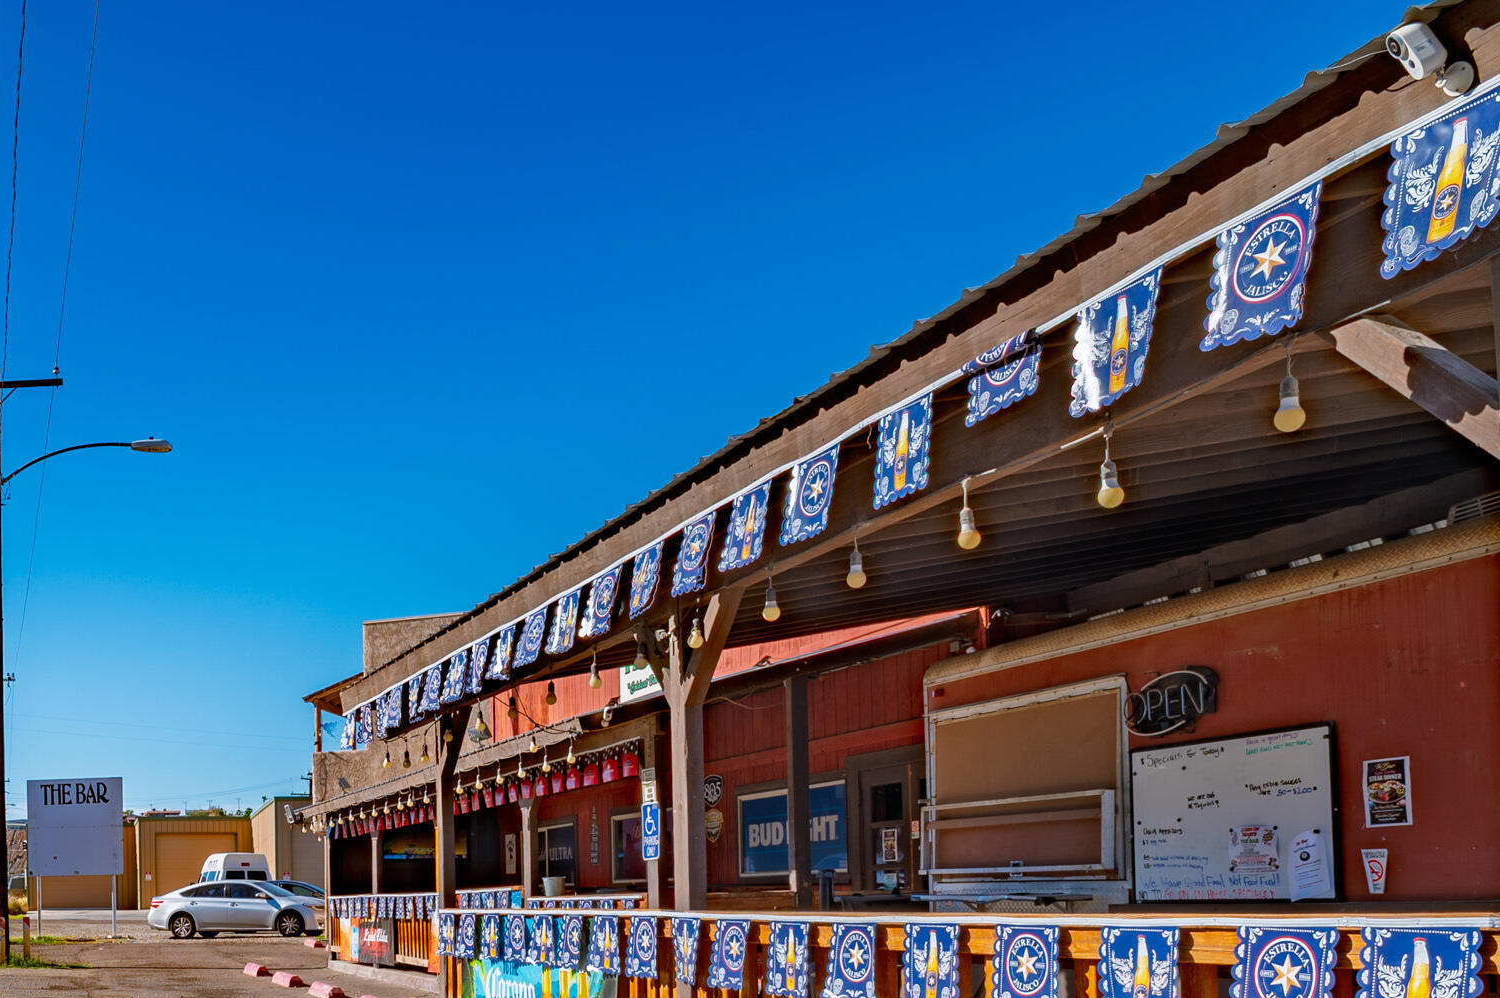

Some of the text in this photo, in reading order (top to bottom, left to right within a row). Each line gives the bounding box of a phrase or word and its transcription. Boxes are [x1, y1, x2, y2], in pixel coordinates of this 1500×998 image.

[1244, 221, 1297, 257] ESTRELLA
[1244, 271, 1288, 297] JALISCO
[1123, 682, 1204, 725] OPEN
[40, 782, 109, 805] THE BAR
[704, 782, 721, 799] 805
[748, 821, 784, 848] BUD
[549, 847, 573, 860] ULTRA
[1011, 938, 1044, 958] ESTRELLA
[1263, 942, 1310, 968] ESTRELLA
[1013, 978, 1040, 992] JALISCO
